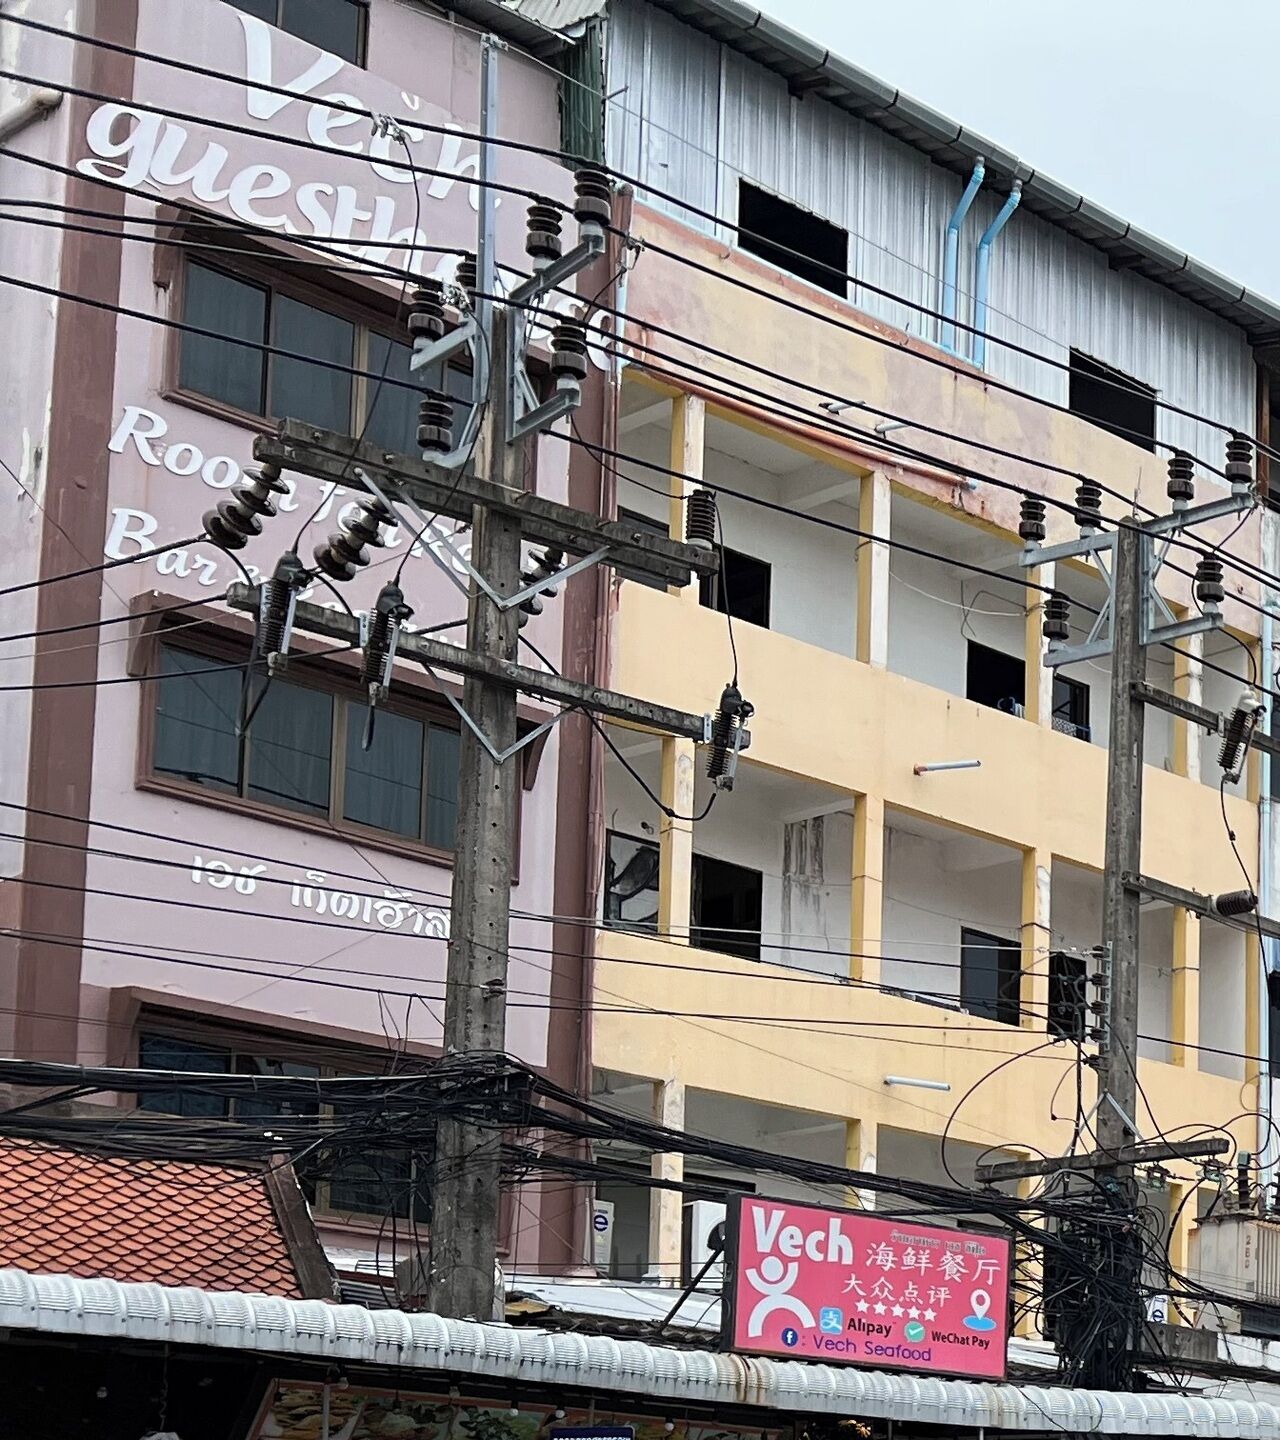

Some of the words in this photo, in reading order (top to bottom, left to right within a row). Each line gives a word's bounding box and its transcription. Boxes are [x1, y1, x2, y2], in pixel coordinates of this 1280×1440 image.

[104, 507, 218, 587] Bar
[751, 1205, 854, 1265] Vech
[865, 1241, 1001, 1286] 海鲜餐厅
[842, 1273, 953, 1308] 大众点评
[847, 1317, 892, 1337] Alipay
[931, 1331, 971, 1346] WeChat
[972, 1336, 990, 1350] Pay
[814, 1333, 861, 1355] Vech
[864, 1340, 932, 1362] Seafood
